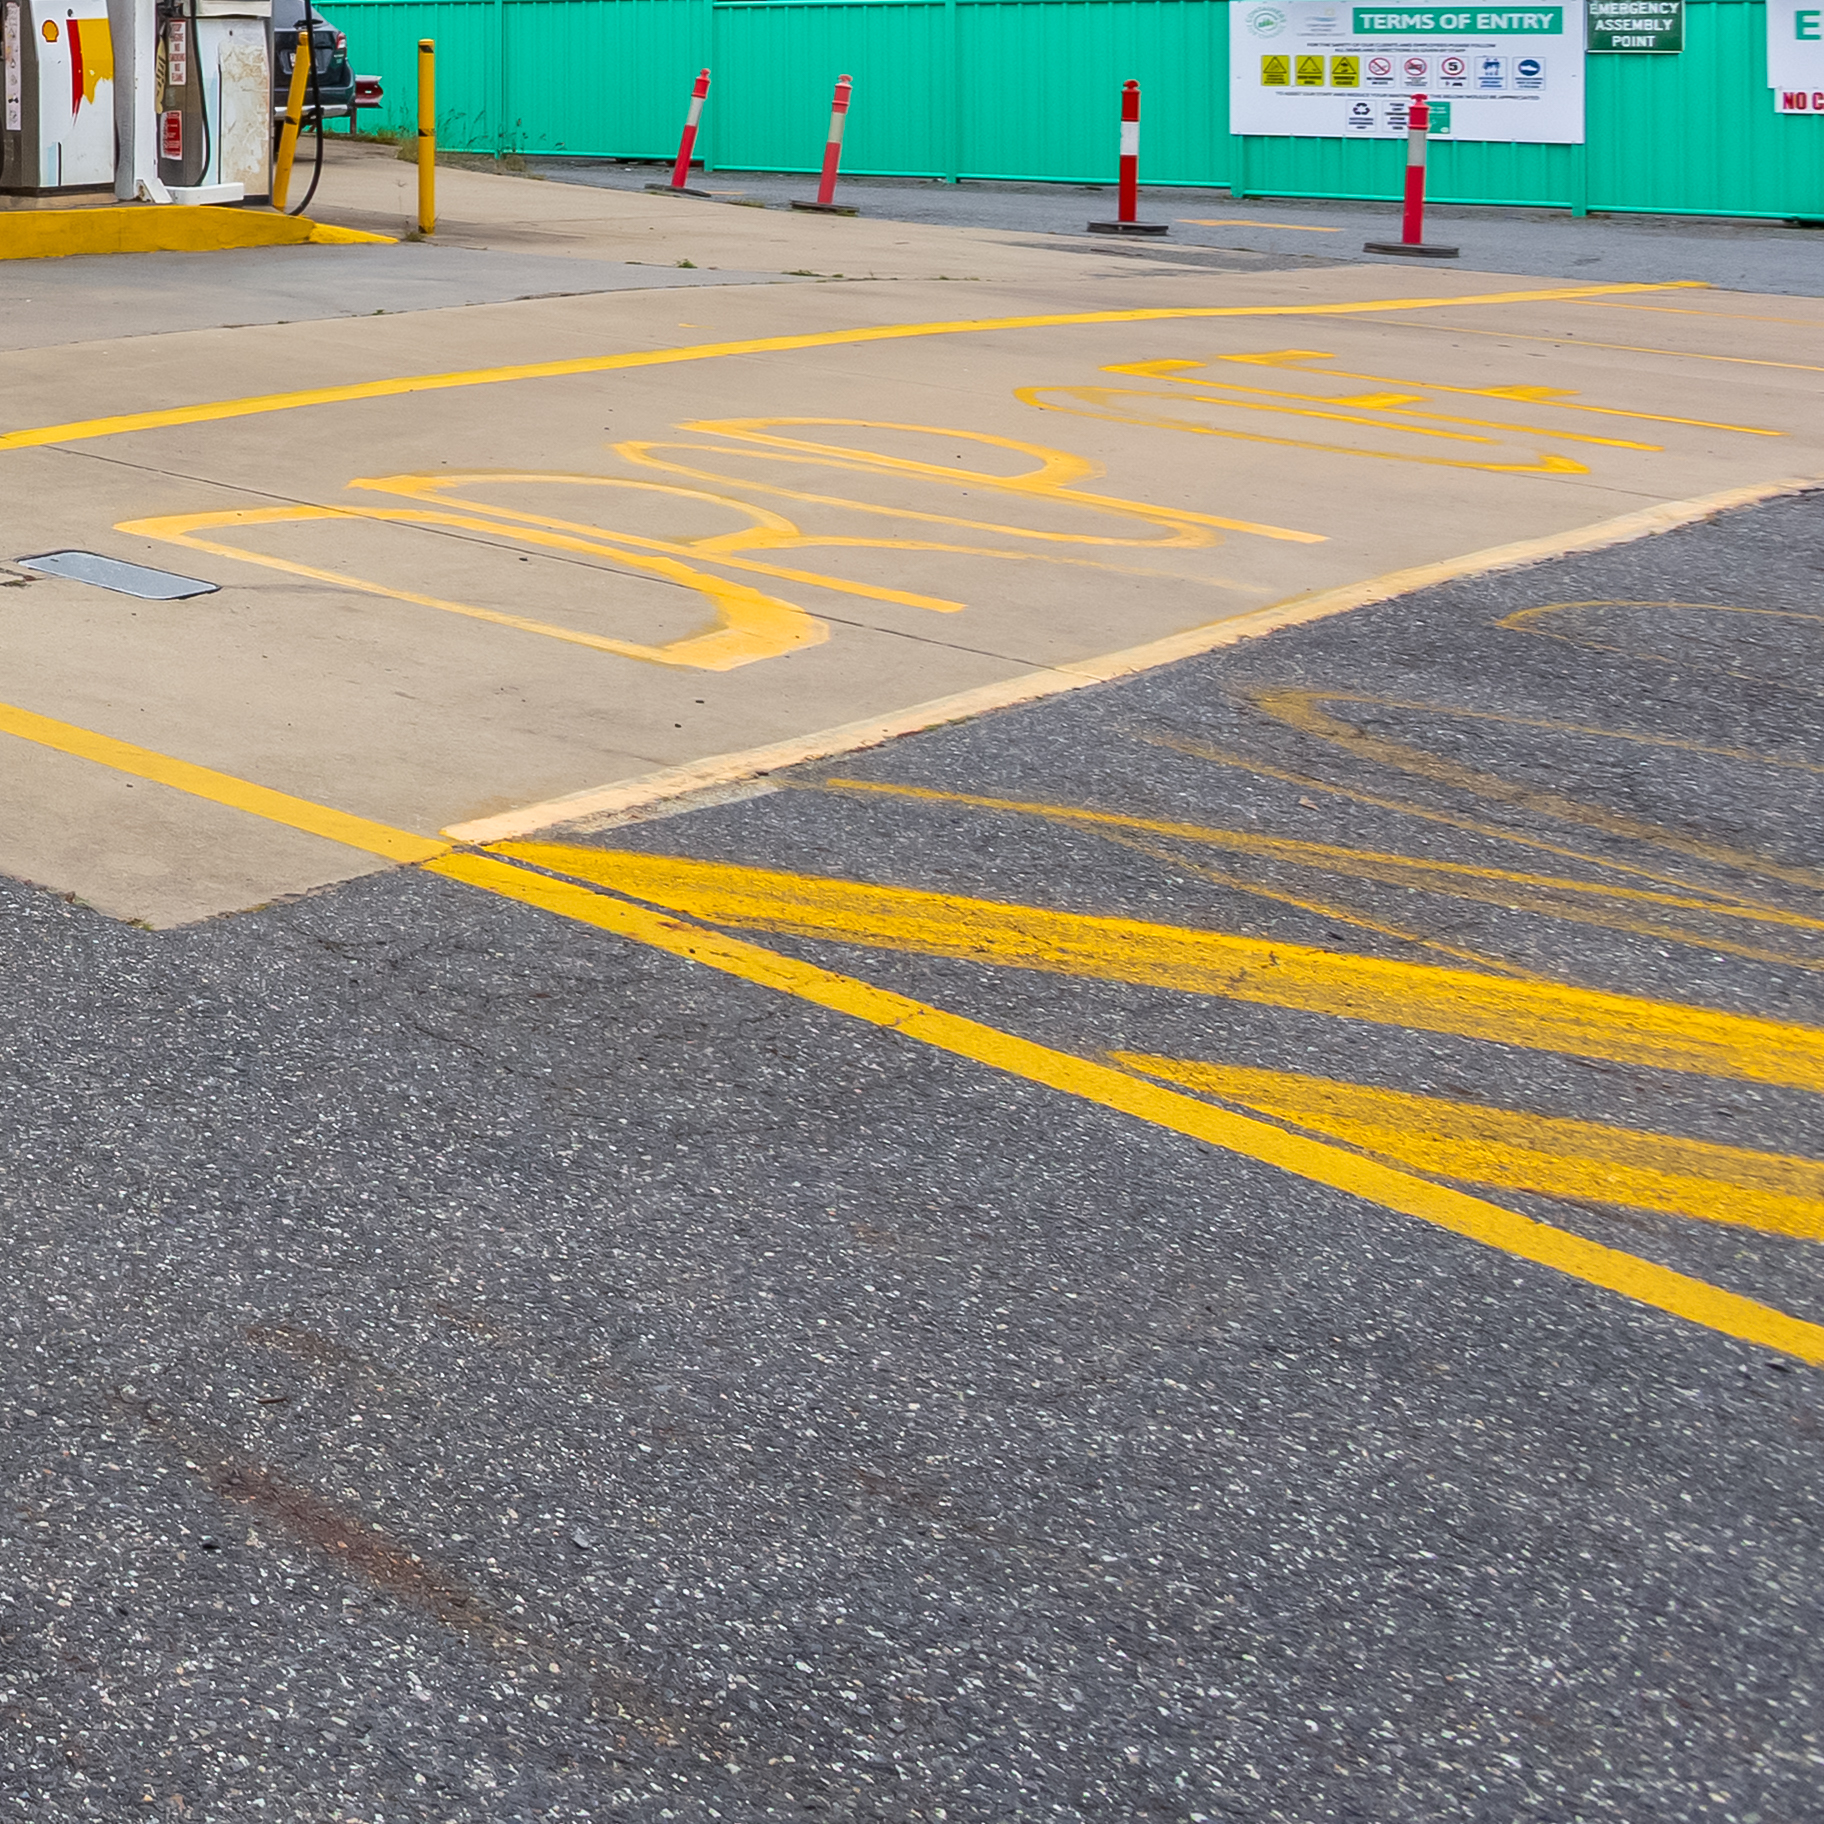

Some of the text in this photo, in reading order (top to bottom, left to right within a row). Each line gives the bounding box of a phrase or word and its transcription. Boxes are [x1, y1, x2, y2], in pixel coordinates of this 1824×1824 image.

[1589, 2, 1680, 15] EMERGENCY
[1359, 13, 1554, 29] TERMS OF ENTRY
[1594, 19, 1673, 31] ASSEMBLY
[1612, 35, 1656, 47] POINT
[1448, 62, 1458, 72] 5
[1783, 92, 1807, 110] NO
